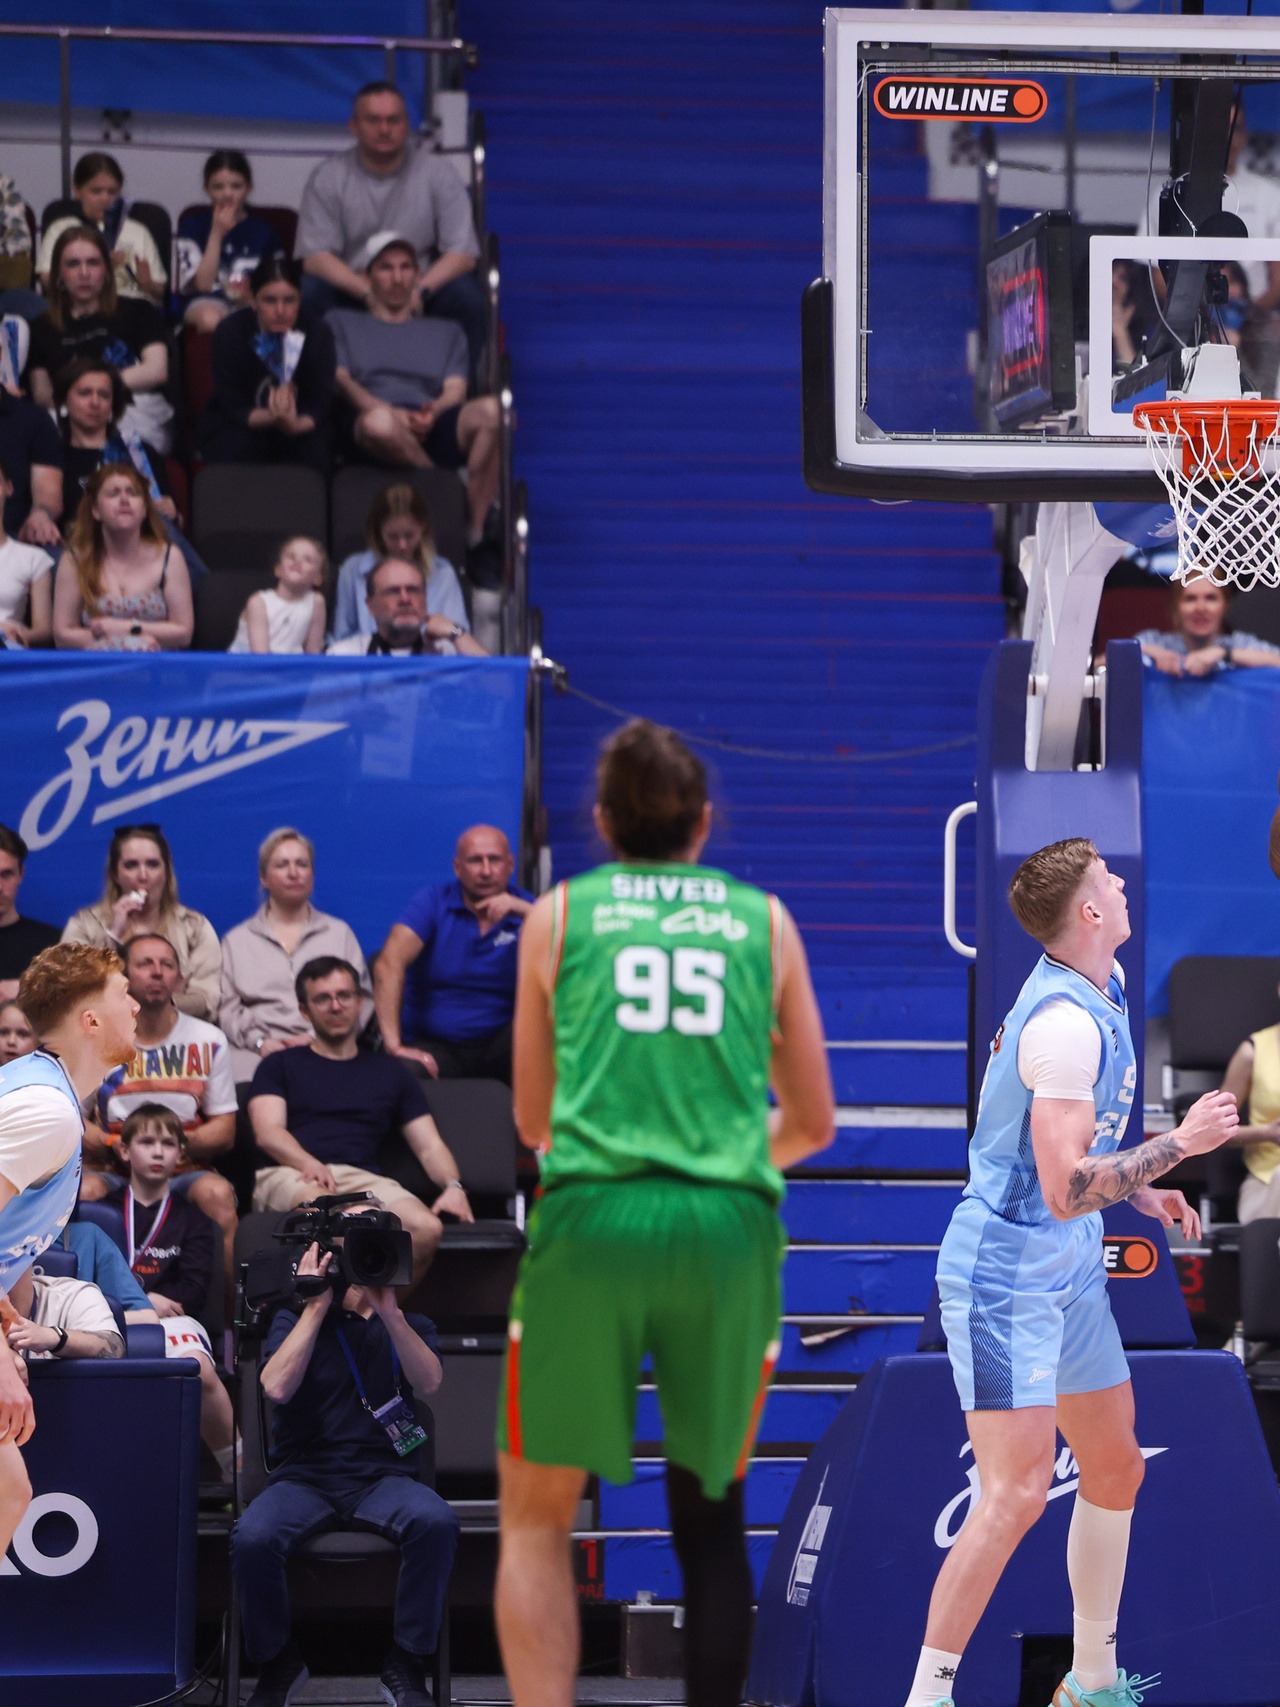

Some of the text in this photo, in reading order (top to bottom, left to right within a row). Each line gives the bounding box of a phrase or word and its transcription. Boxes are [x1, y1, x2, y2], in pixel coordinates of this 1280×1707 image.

[888, 86, 1009, 112] WINLINE
[611, 873, 728, 904] SHVED
[614, 945, 727, 1036] 95
[581, 1540, 597, 1579] 1
